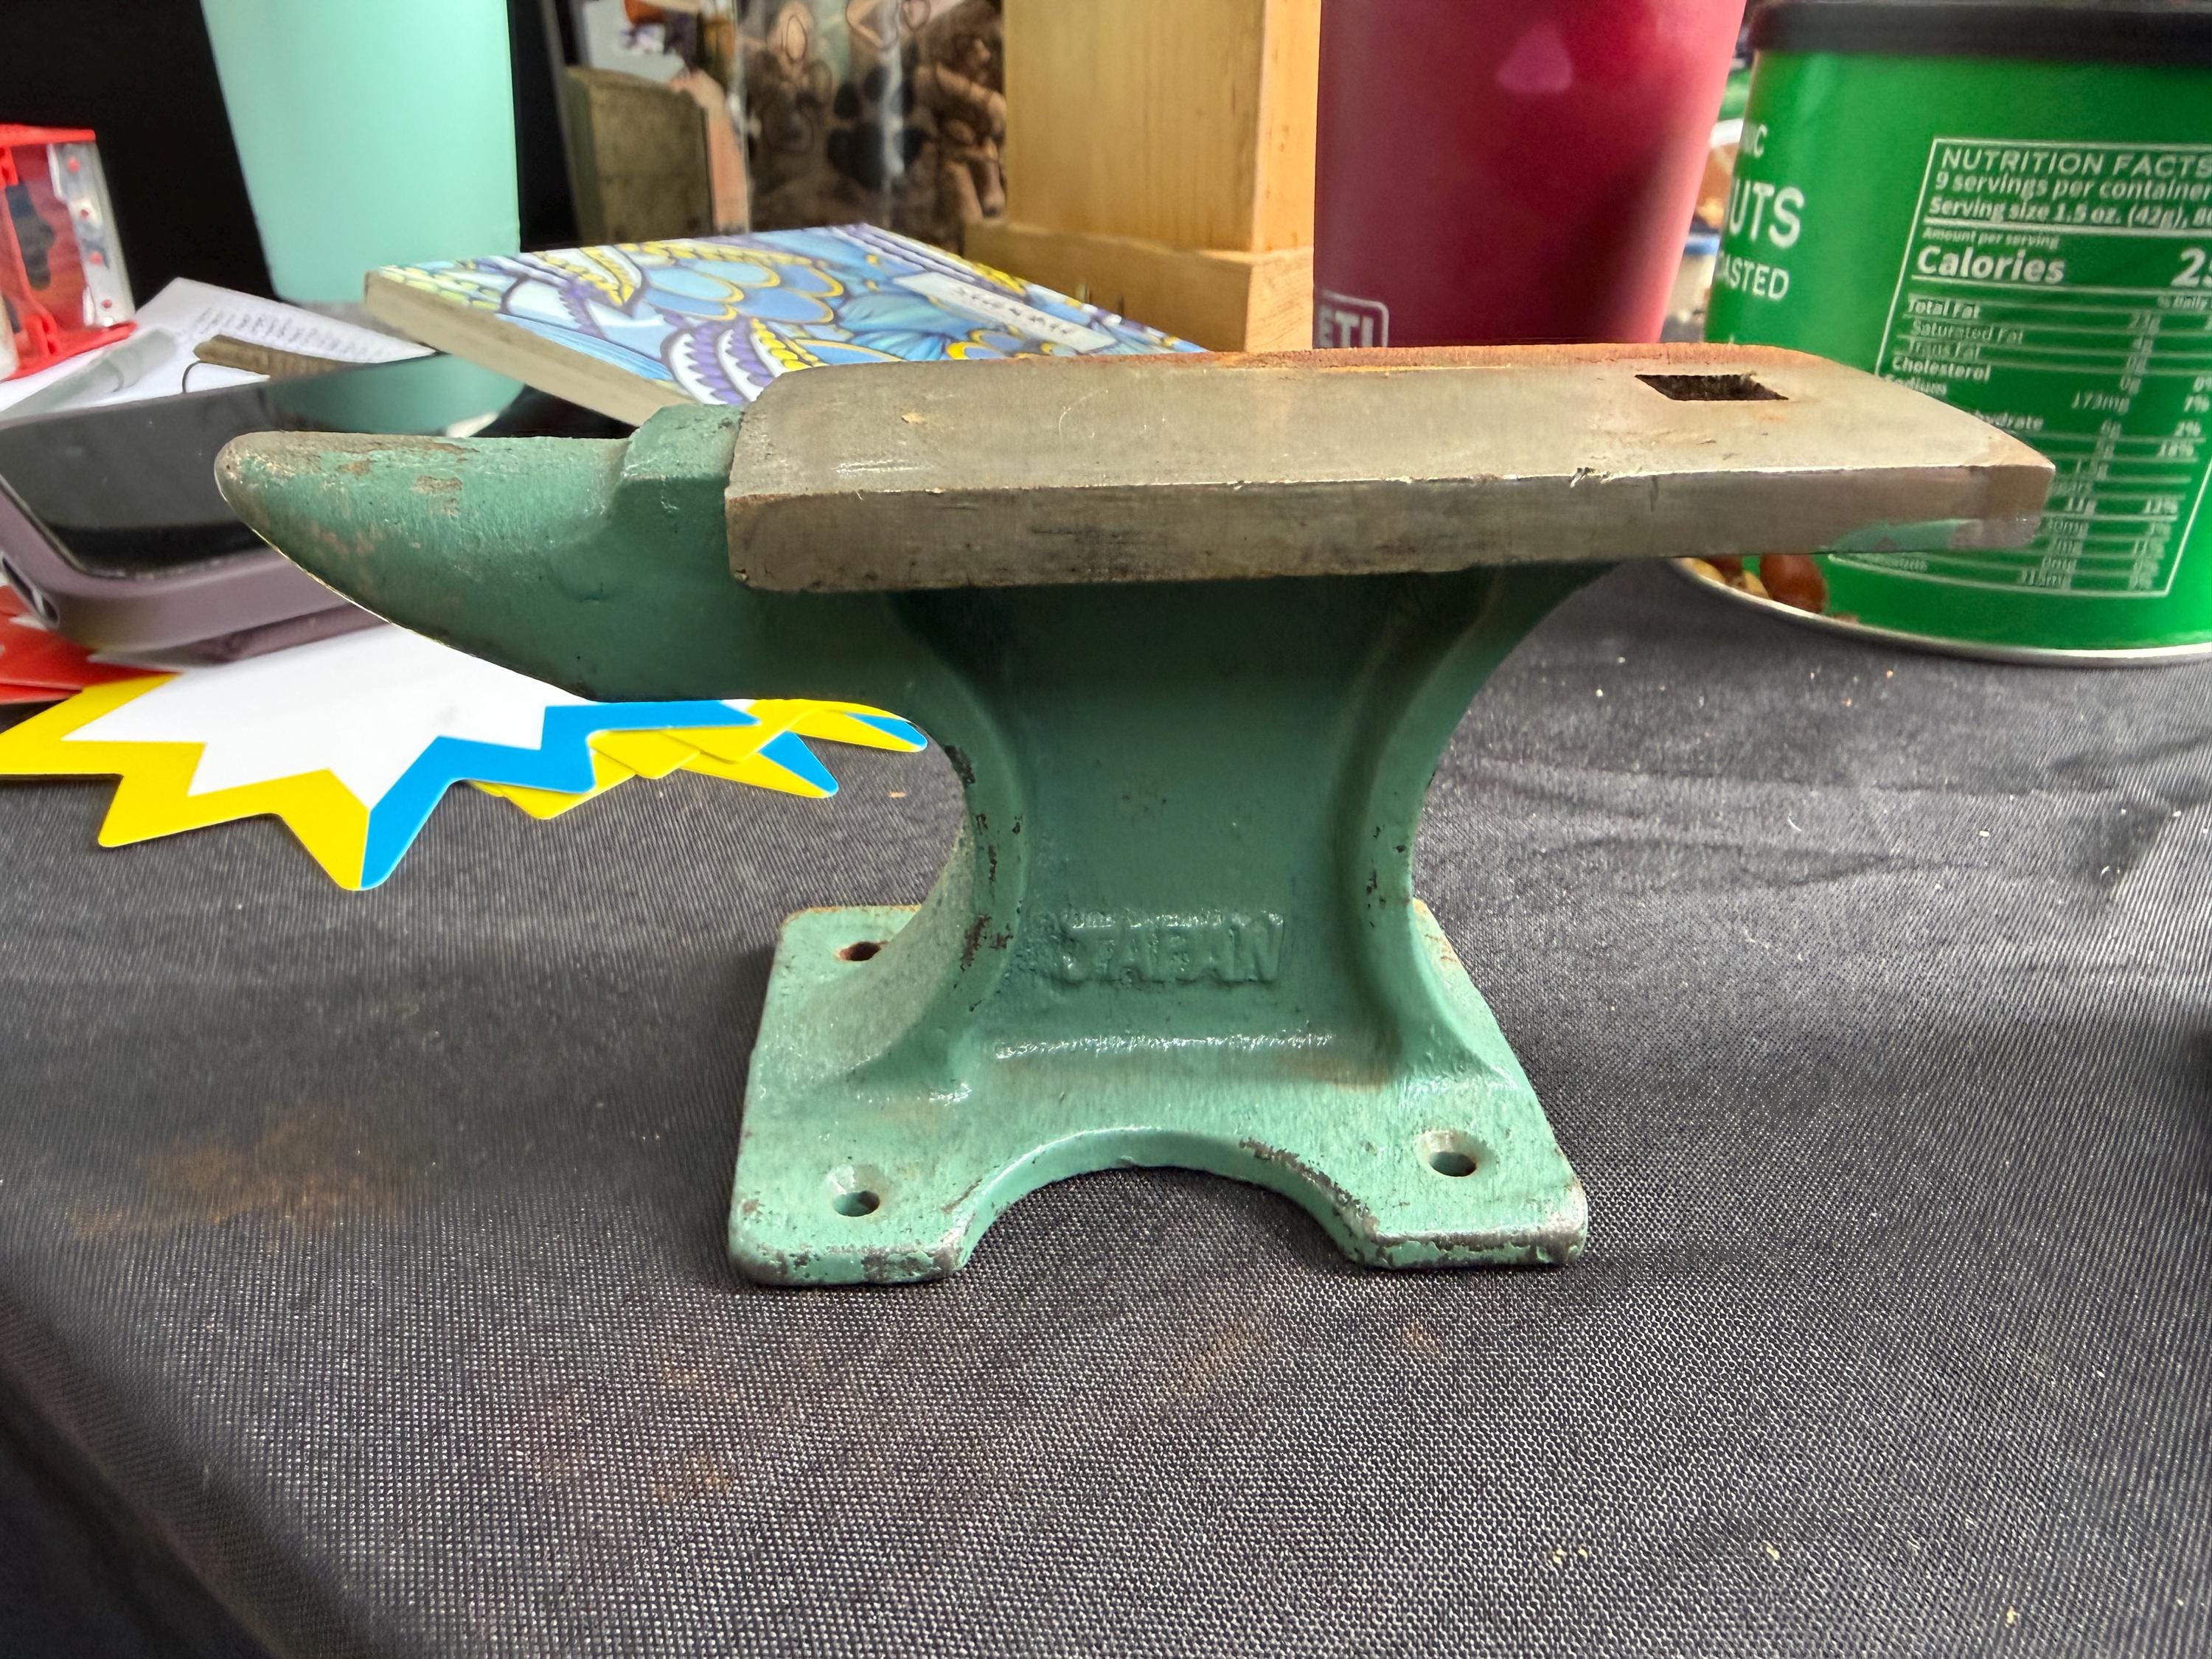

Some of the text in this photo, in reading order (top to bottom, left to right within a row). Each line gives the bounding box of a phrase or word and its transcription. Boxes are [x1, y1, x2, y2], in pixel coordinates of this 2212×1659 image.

[1942, 147, 2212, 178] NUTRITION FACTS
[1954, 174, 2049, 200] servings
[2052, 178, 2096, 201] per
[1928, 195, 2006, 222] Serving
[2008, 199, 2051, 220] size
[1917, 245, 2065, 285] Calories
[1062, 908, 1284, 984] JAPAN
